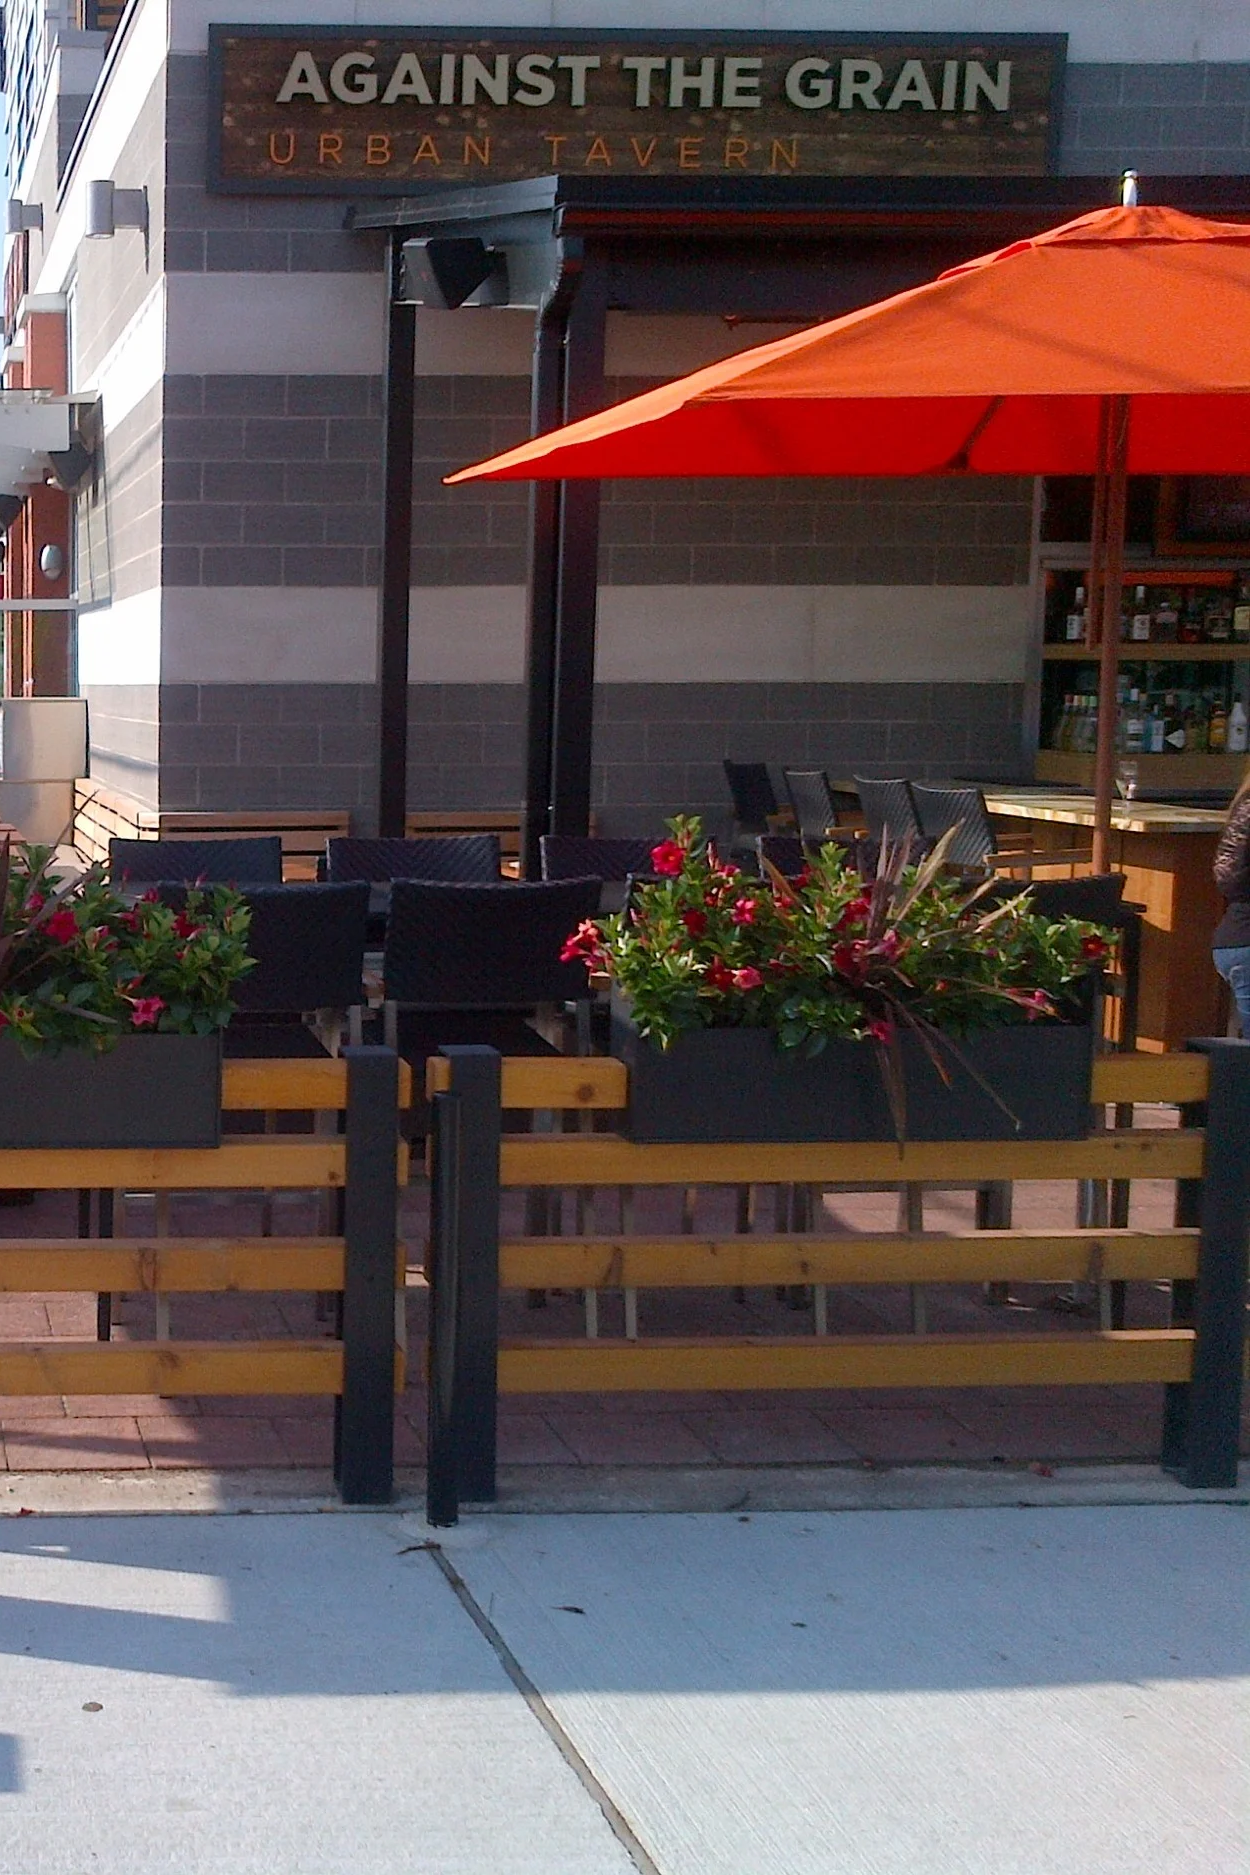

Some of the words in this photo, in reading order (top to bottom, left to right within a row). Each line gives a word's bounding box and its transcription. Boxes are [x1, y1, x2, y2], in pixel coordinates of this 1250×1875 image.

[275, 50, 601, 107] AGAINST
[622, 55, 763, 108] THE
[784, 56, 1012, 111] GRAIN
[268, 132, 492, 165] URBAN
[544, 135, 799, 169] TAVERN
